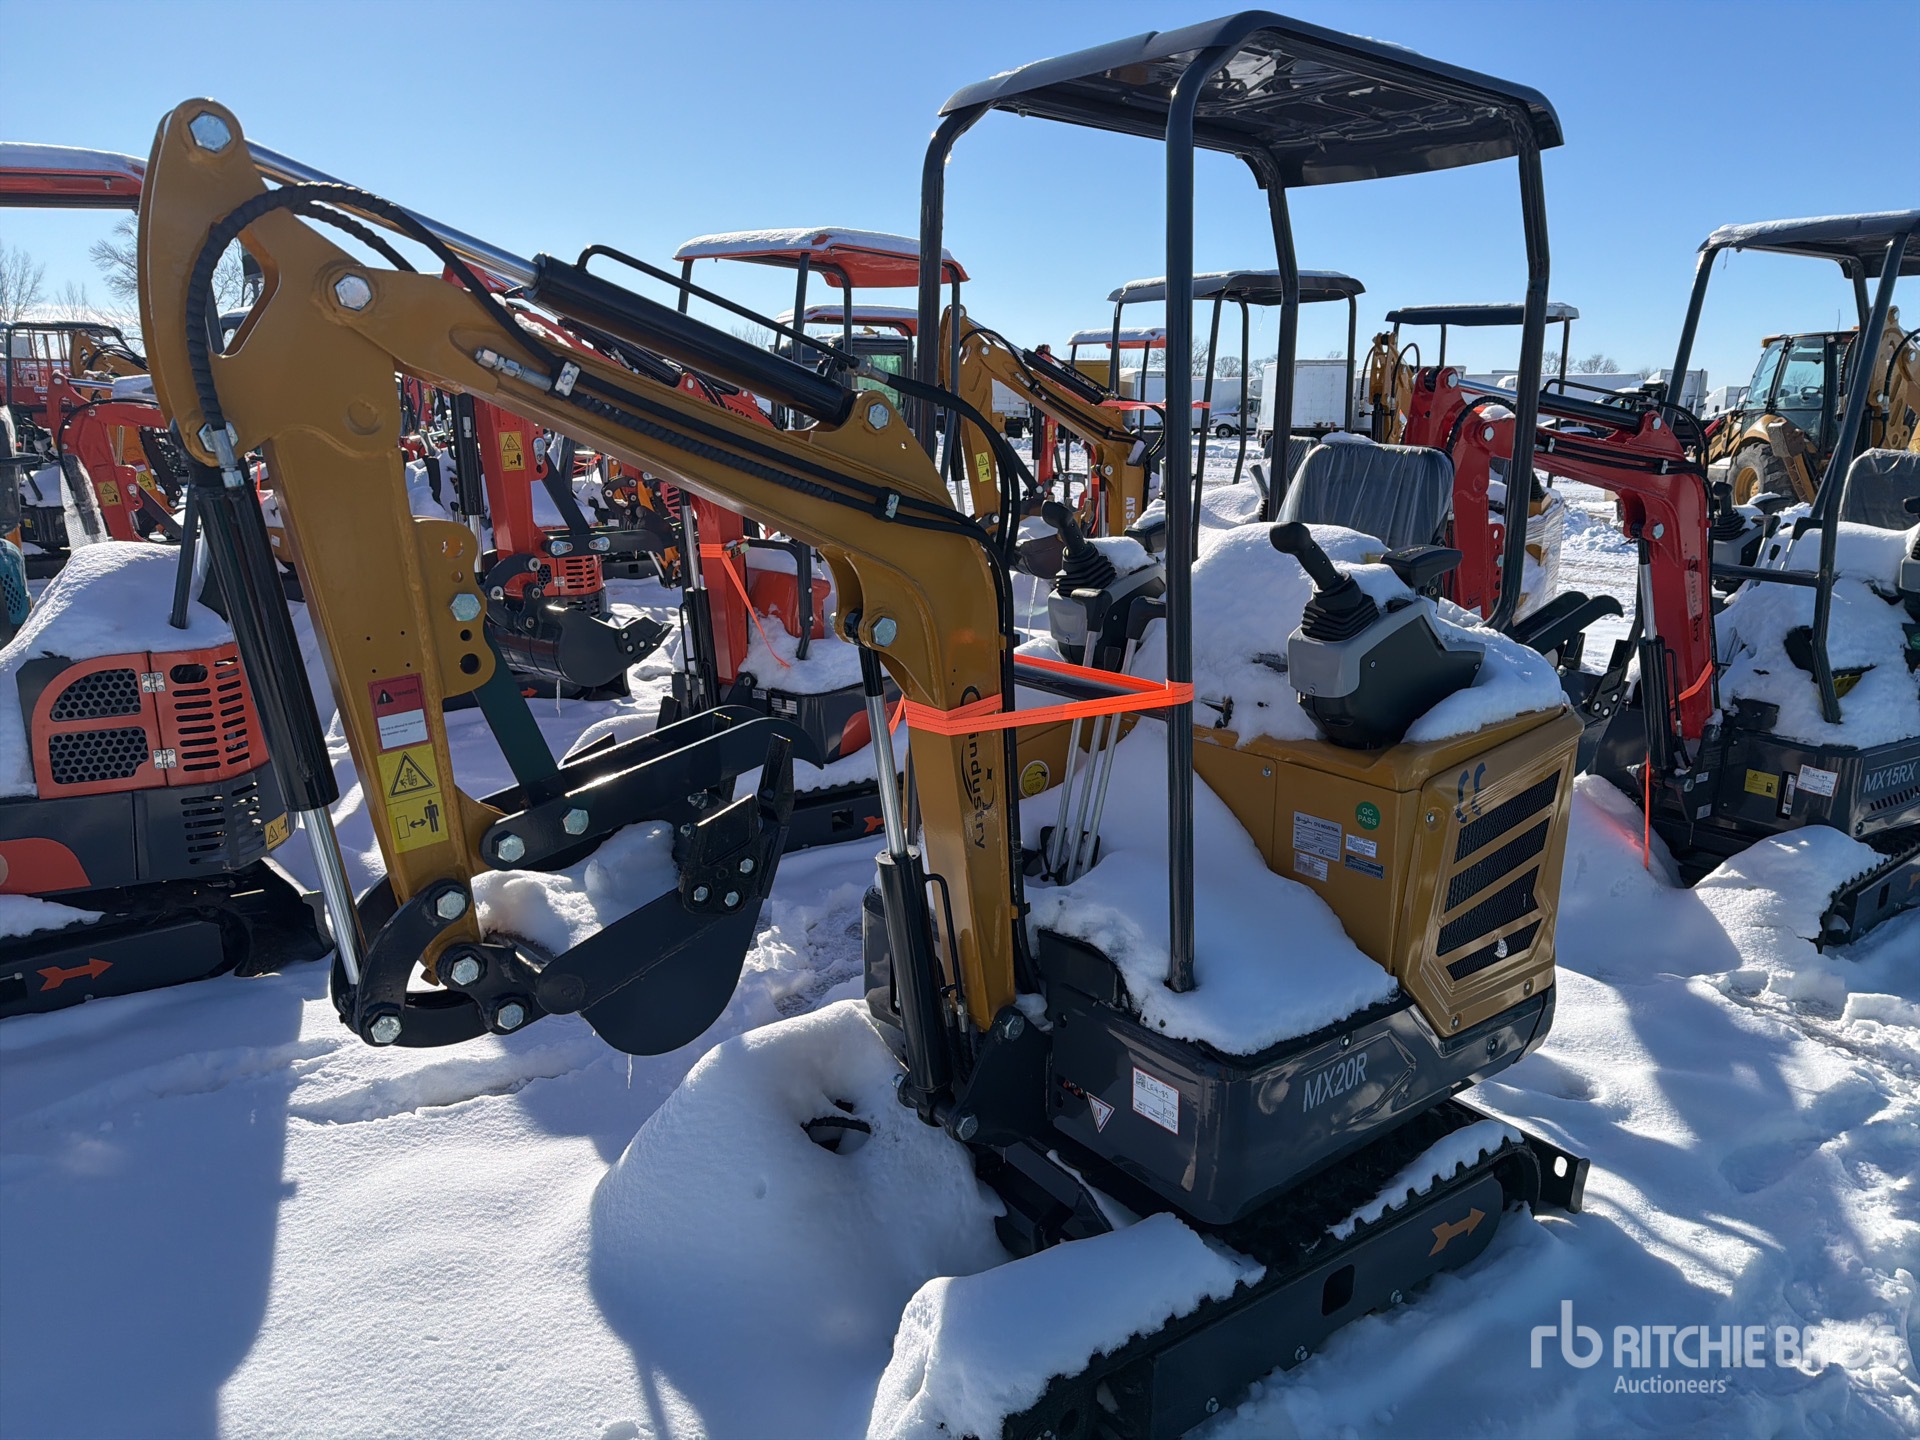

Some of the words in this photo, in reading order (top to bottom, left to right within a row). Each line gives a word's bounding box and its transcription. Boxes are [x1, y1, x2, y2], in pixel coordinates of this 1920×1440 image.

[1126, 497, 1135, 528] ATS-
[1863, 761, 1918, 794] MX15RX
[1357, 814, 1377, 827] PASS
[1361, 807, 1374, 817] QC
[1302, 1052, 1368, 1113] MX20R
